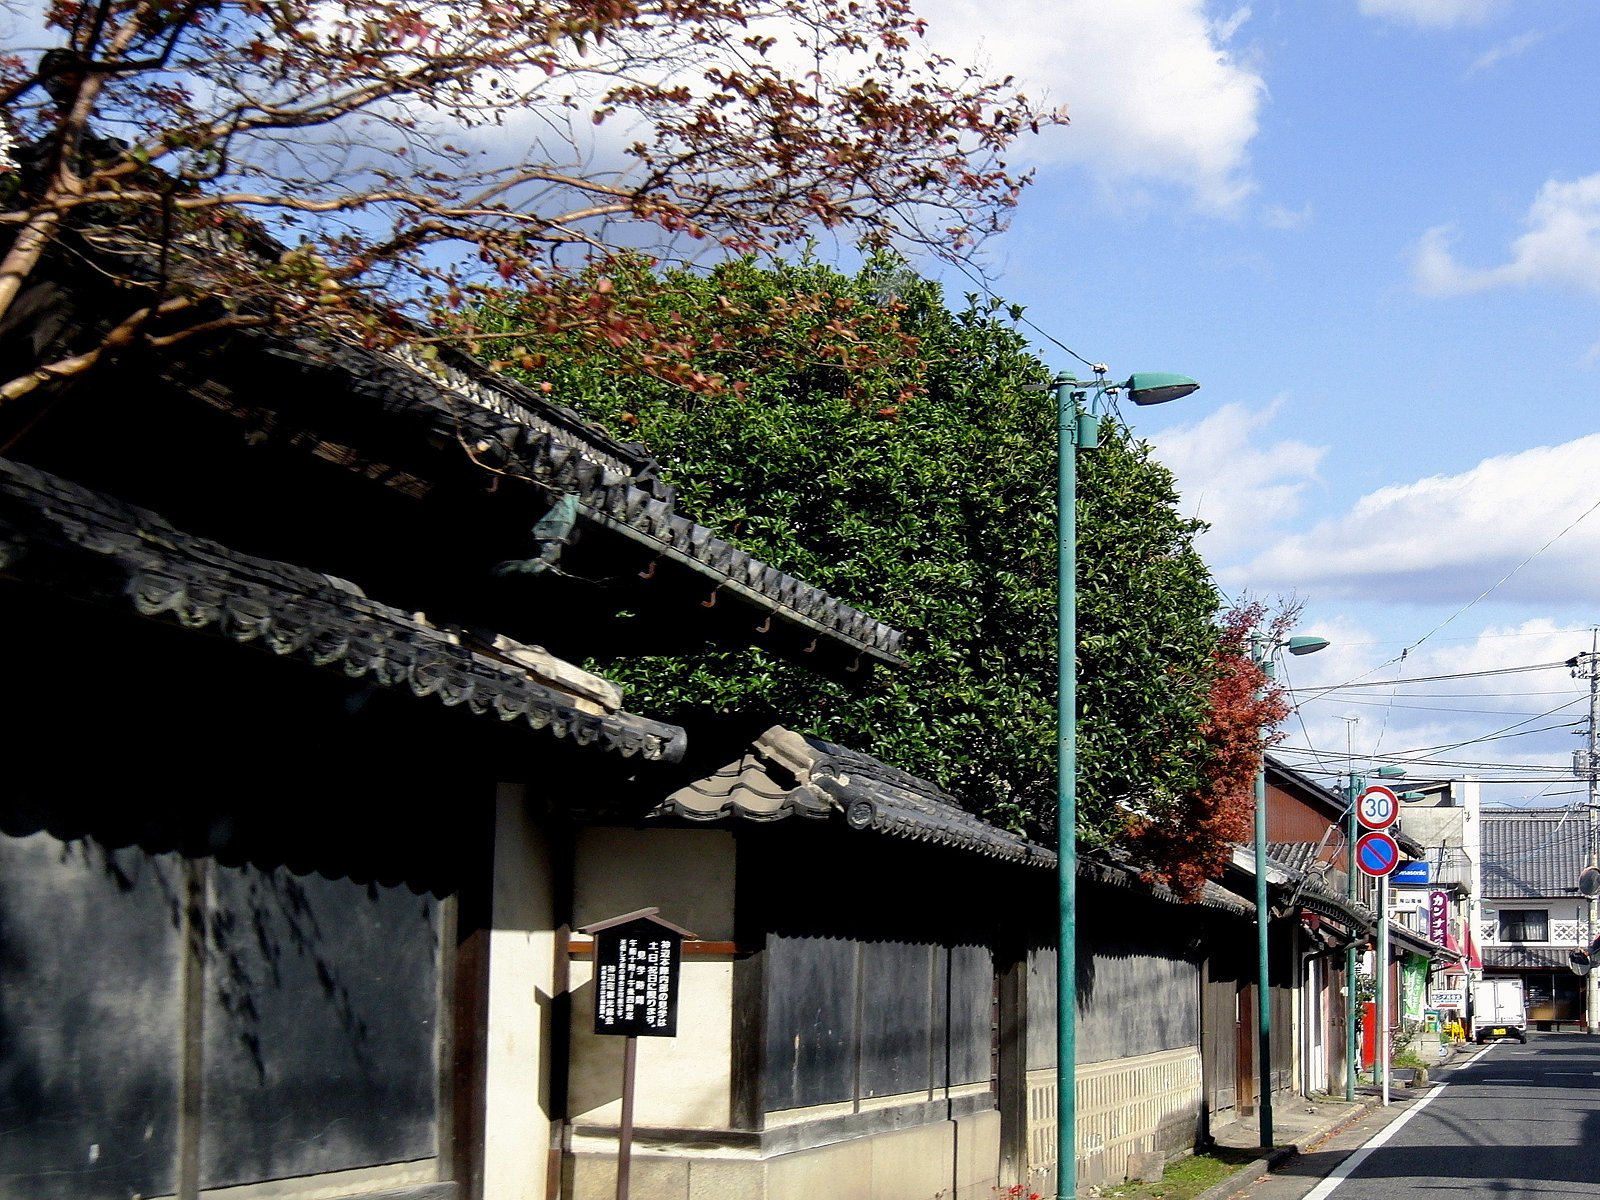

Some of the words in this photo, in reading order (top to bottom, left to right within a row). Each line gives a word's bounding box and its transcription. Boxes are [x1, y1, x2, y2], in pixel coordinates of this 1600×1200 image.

[1365, 799, 1389, 818] 30
[635, 950, 647, 1005] 見学時間
[657, 940, 671, 1027] 神辺本陣内部の見学は
